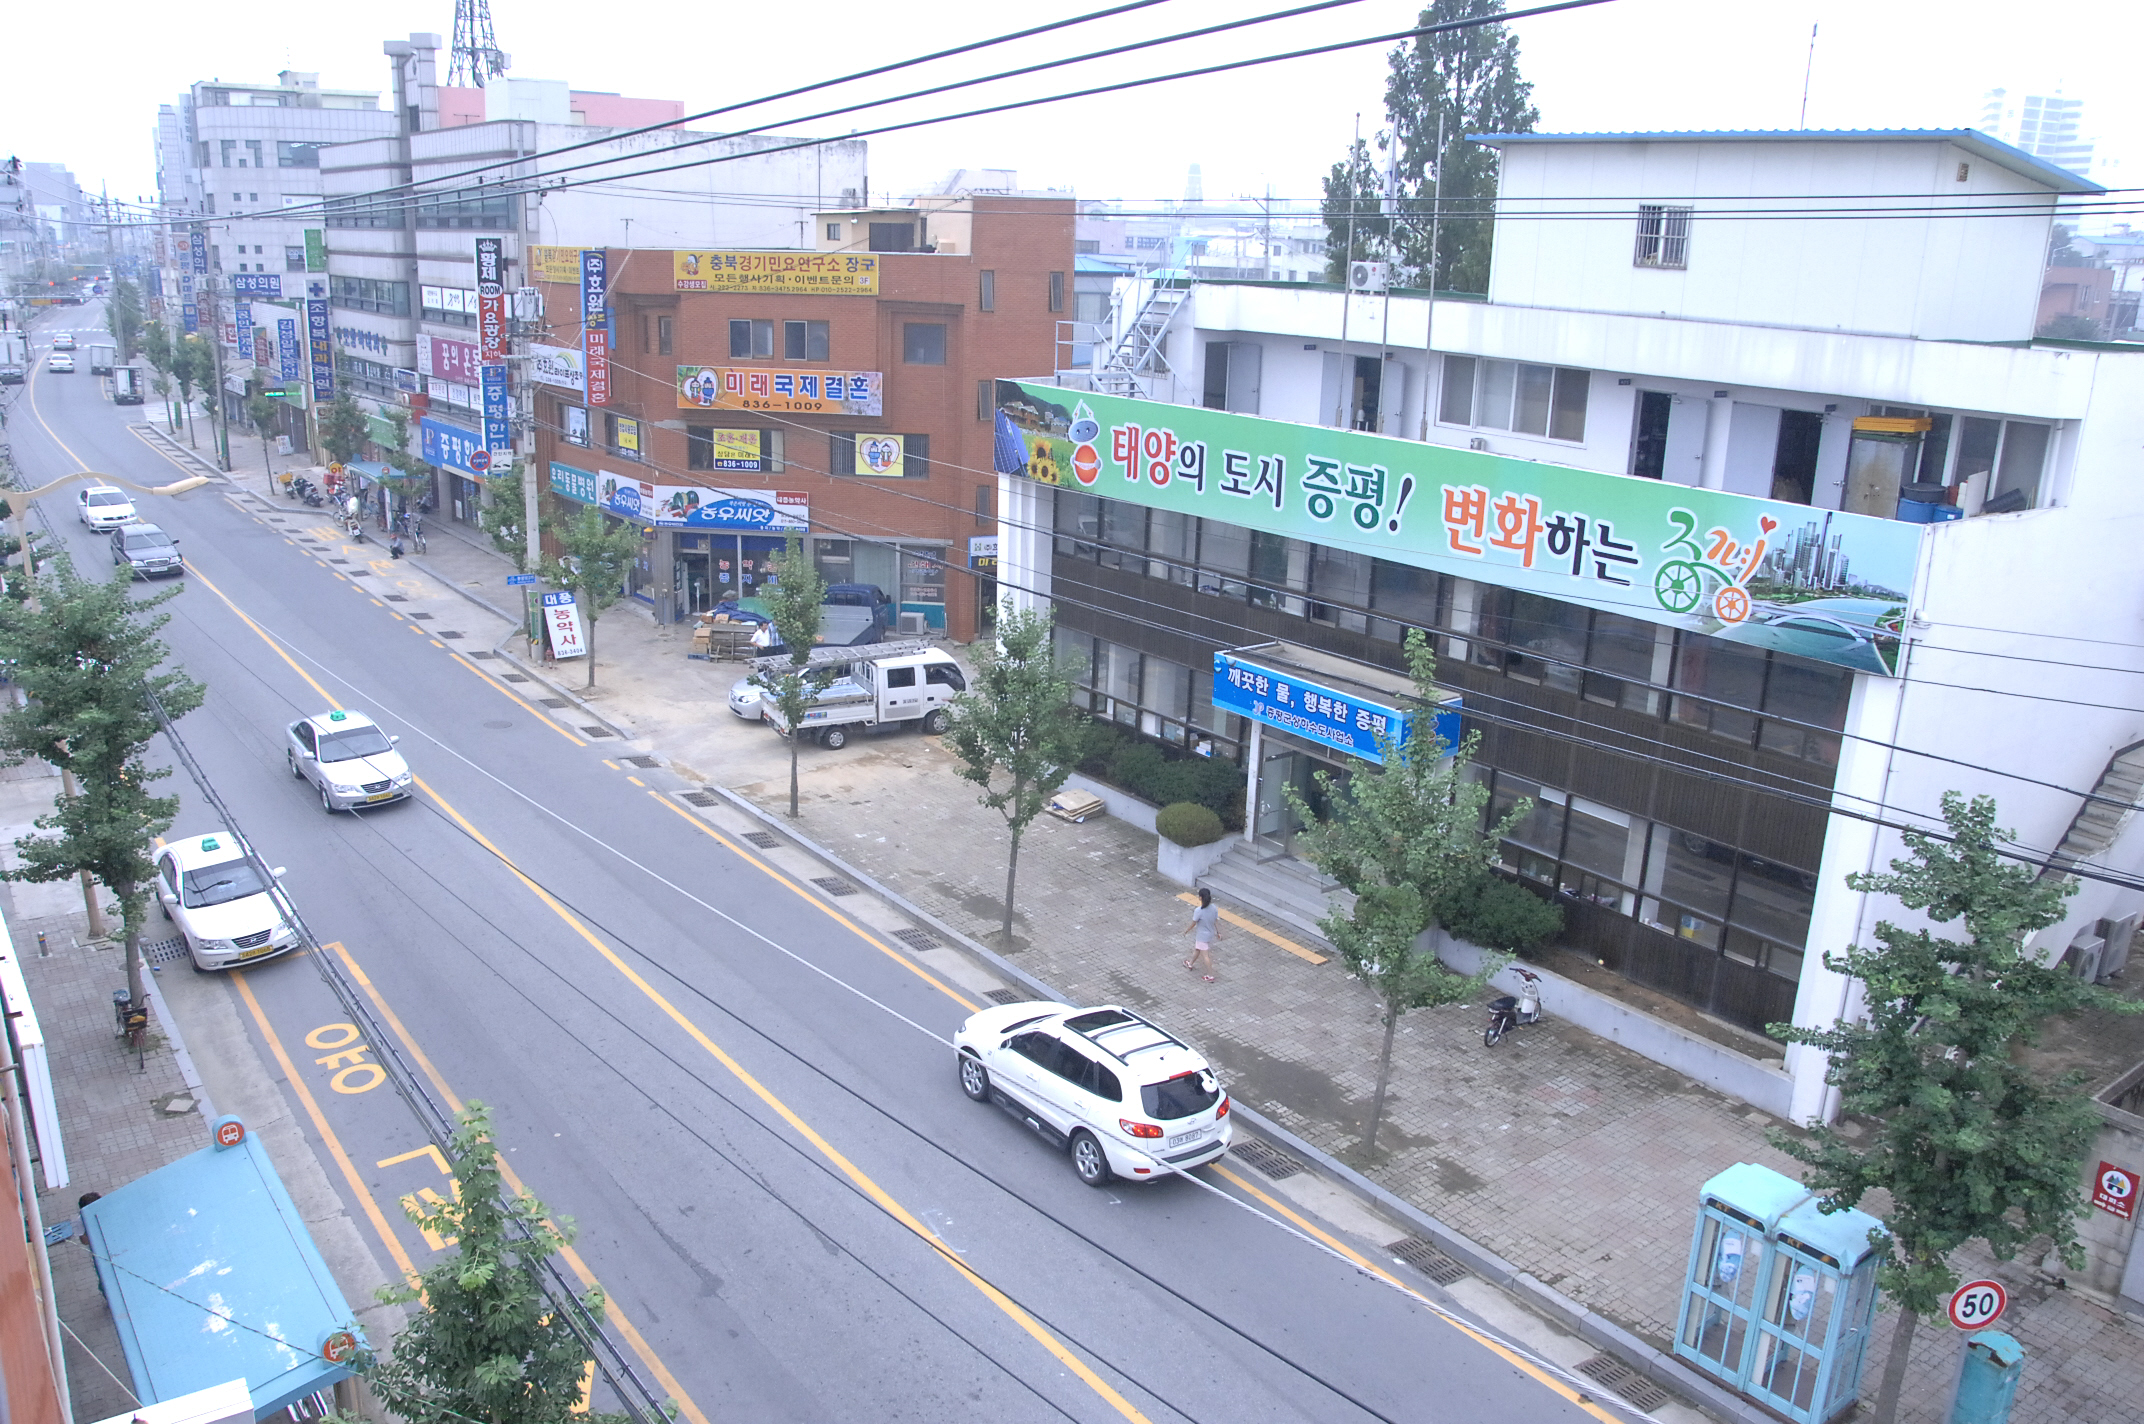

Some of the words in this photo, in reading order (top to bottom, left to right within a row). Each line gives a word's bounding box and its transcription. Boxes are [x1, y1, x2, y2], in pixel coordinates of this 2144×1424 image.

[480, 252, 497, 281] 황제
[846, 256, 875, 271] 장구
[235, 277, 280, 290] 삼성의원
[480, 285, 500, 295] ROOM
[483, 300, 500, 349] 가요광장
[589, 333, 606, 404] 미래국제결혼
[724, 371, 870, 400] 미래국제결혼
[742, 400, 823, 411] 836-1009
[723, 460, 758, 469] 836-1009
[551, 467, 595, 501] 우리동물병원
[614, 492, 640, 512] 농우씨앗
[701, 506, 771, 523] 농우씨앗
[1112, 426, 1206, 493] 태양의
[1220, 451, 1285, 508] 도시
[1303, 457, 1414, 532] 증평!
[1443, 487, 1640, 586] 변화하는
[544, 591, 573, 605] 대풍
[553, 609, 577, 646] 농약사
[1227, 667, 1270, 697] 깨끗한
[1275, 682, 1296, 709] 물,
[1303, 690, 1349, 724] 행복한
[1355, 708, 1388, 736] 증평
[1266, 705, 1354, 747] 증평군상하수도사업소
[1962, 1291, 1994, 1319] 50
